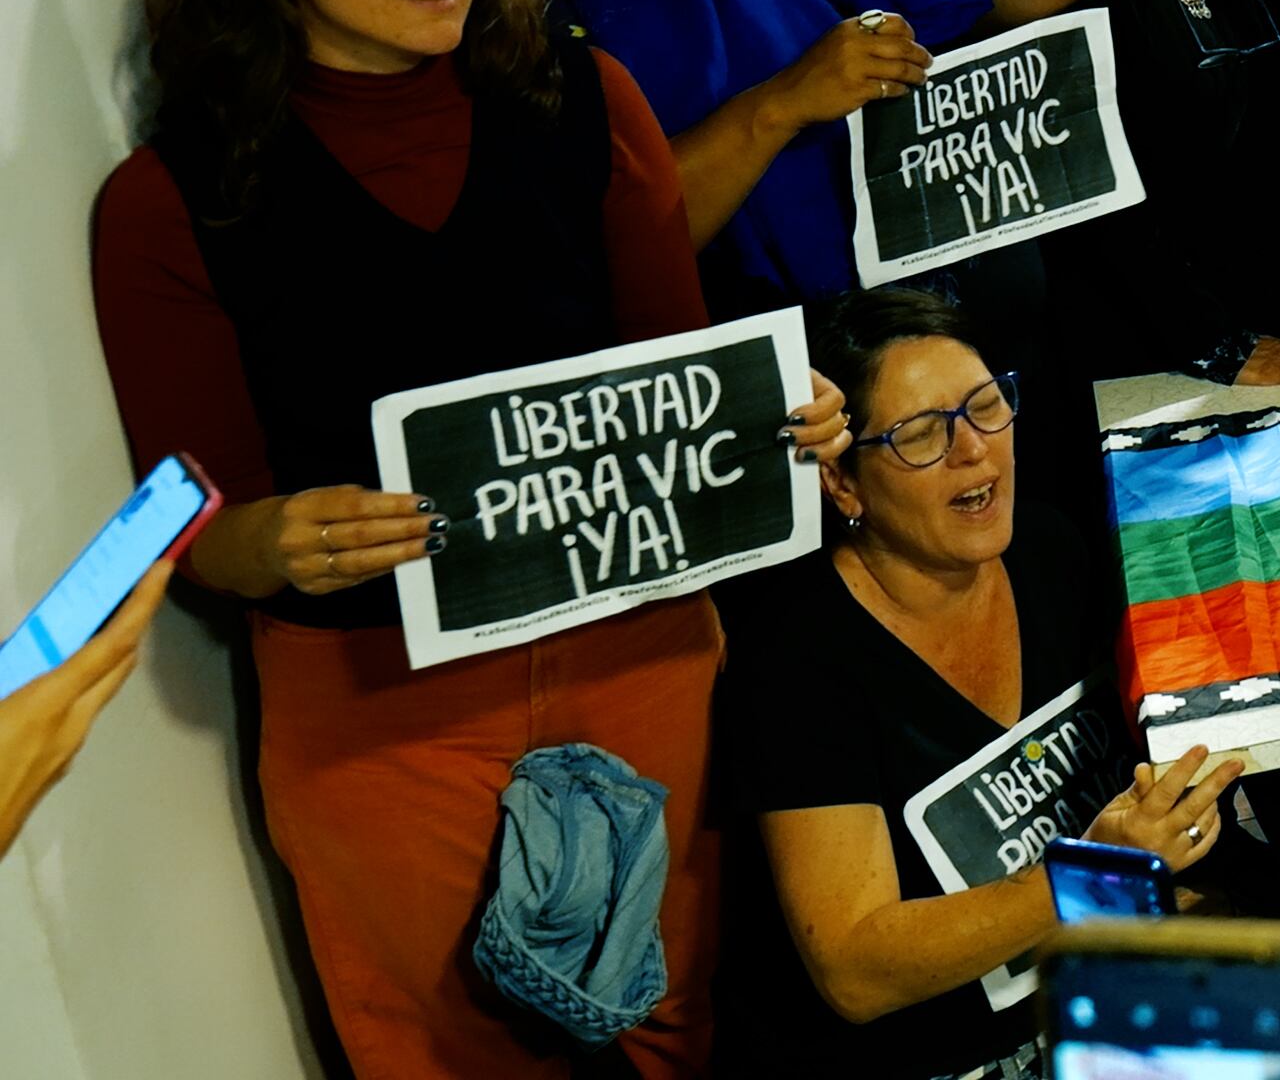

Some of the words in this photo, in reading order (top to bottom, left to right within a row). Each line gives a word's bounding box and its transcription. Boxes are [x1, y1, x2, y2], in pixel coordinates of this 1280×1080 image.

[899, 121, 998, 189] PARA
[1001, 98, 1071, 155] VIC
[955, 154, 1045, 235] ¡YA!
[474, 453, 631, 541] PARA
[637, 429, 745, 500] VIC
[562, 499, 690, 600] ¡YA!
